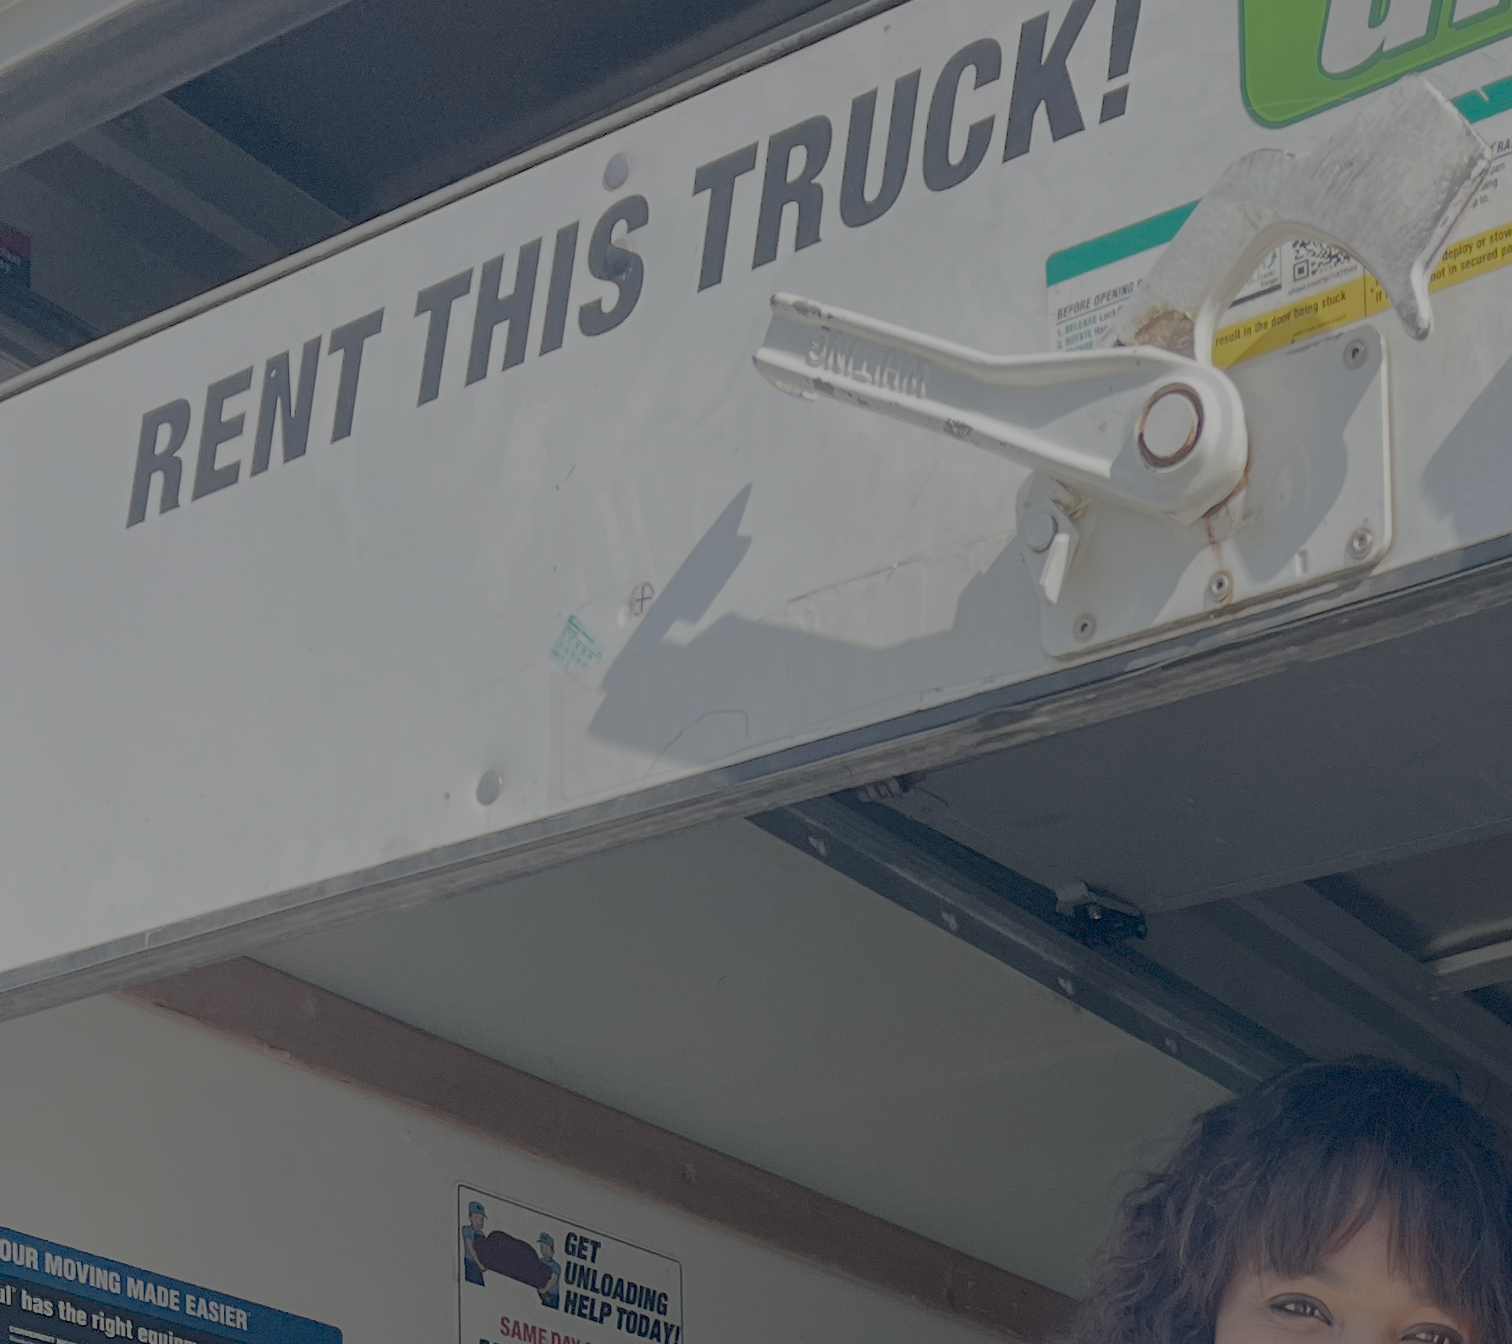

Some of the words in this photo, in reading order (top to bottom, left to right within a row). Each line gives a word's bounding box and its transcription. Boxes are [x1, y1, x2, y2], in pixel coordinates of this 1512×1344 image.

[1442, 242, 1473, 262] deploy
[1476, 236, 1485, 249] or
[1490, 228, 1512, 243] stow
[125, 308, 386, 528] RENT
[416, 195, 650, 406] THIS
[690, 0, 1143, 292] TRUCK!
[1431, 267, 1445, 283] not
[1449, 263, 1457, 276] in
[1460, 250, 1498, 271] secured
[1057, 297, 1091, 320] BEFORE
[1094, 282, 1134, 306] OPENING
[1215, 330, 1240, 347] result
[1244, 326, 1251, 335] in
[1255, 320, 1268, 332] the
[1272, 312, 1291, 327] door
[1294, 302, 1318, 318] being
[1322, 291, 1346, 309] stuck
[1065, 315, 1097, 334] RELEASE
[1066, 329, 1091, 346] ROTATE
[564, 1232, 601, 1264] GET
[45, 1252, 121, 1294] MOVING
[127, 1275, 180, 1312] MADE
[186, 1295, 248, 1331] EASIER
[564, 1261, 668, 1316] UNLOADING
[564, 1289, 611, 1324] HELP
[22, 1289, 53, 1317] has
[59, 1301, 87, 1326] the
[92, 1311, 133, 1339] right
